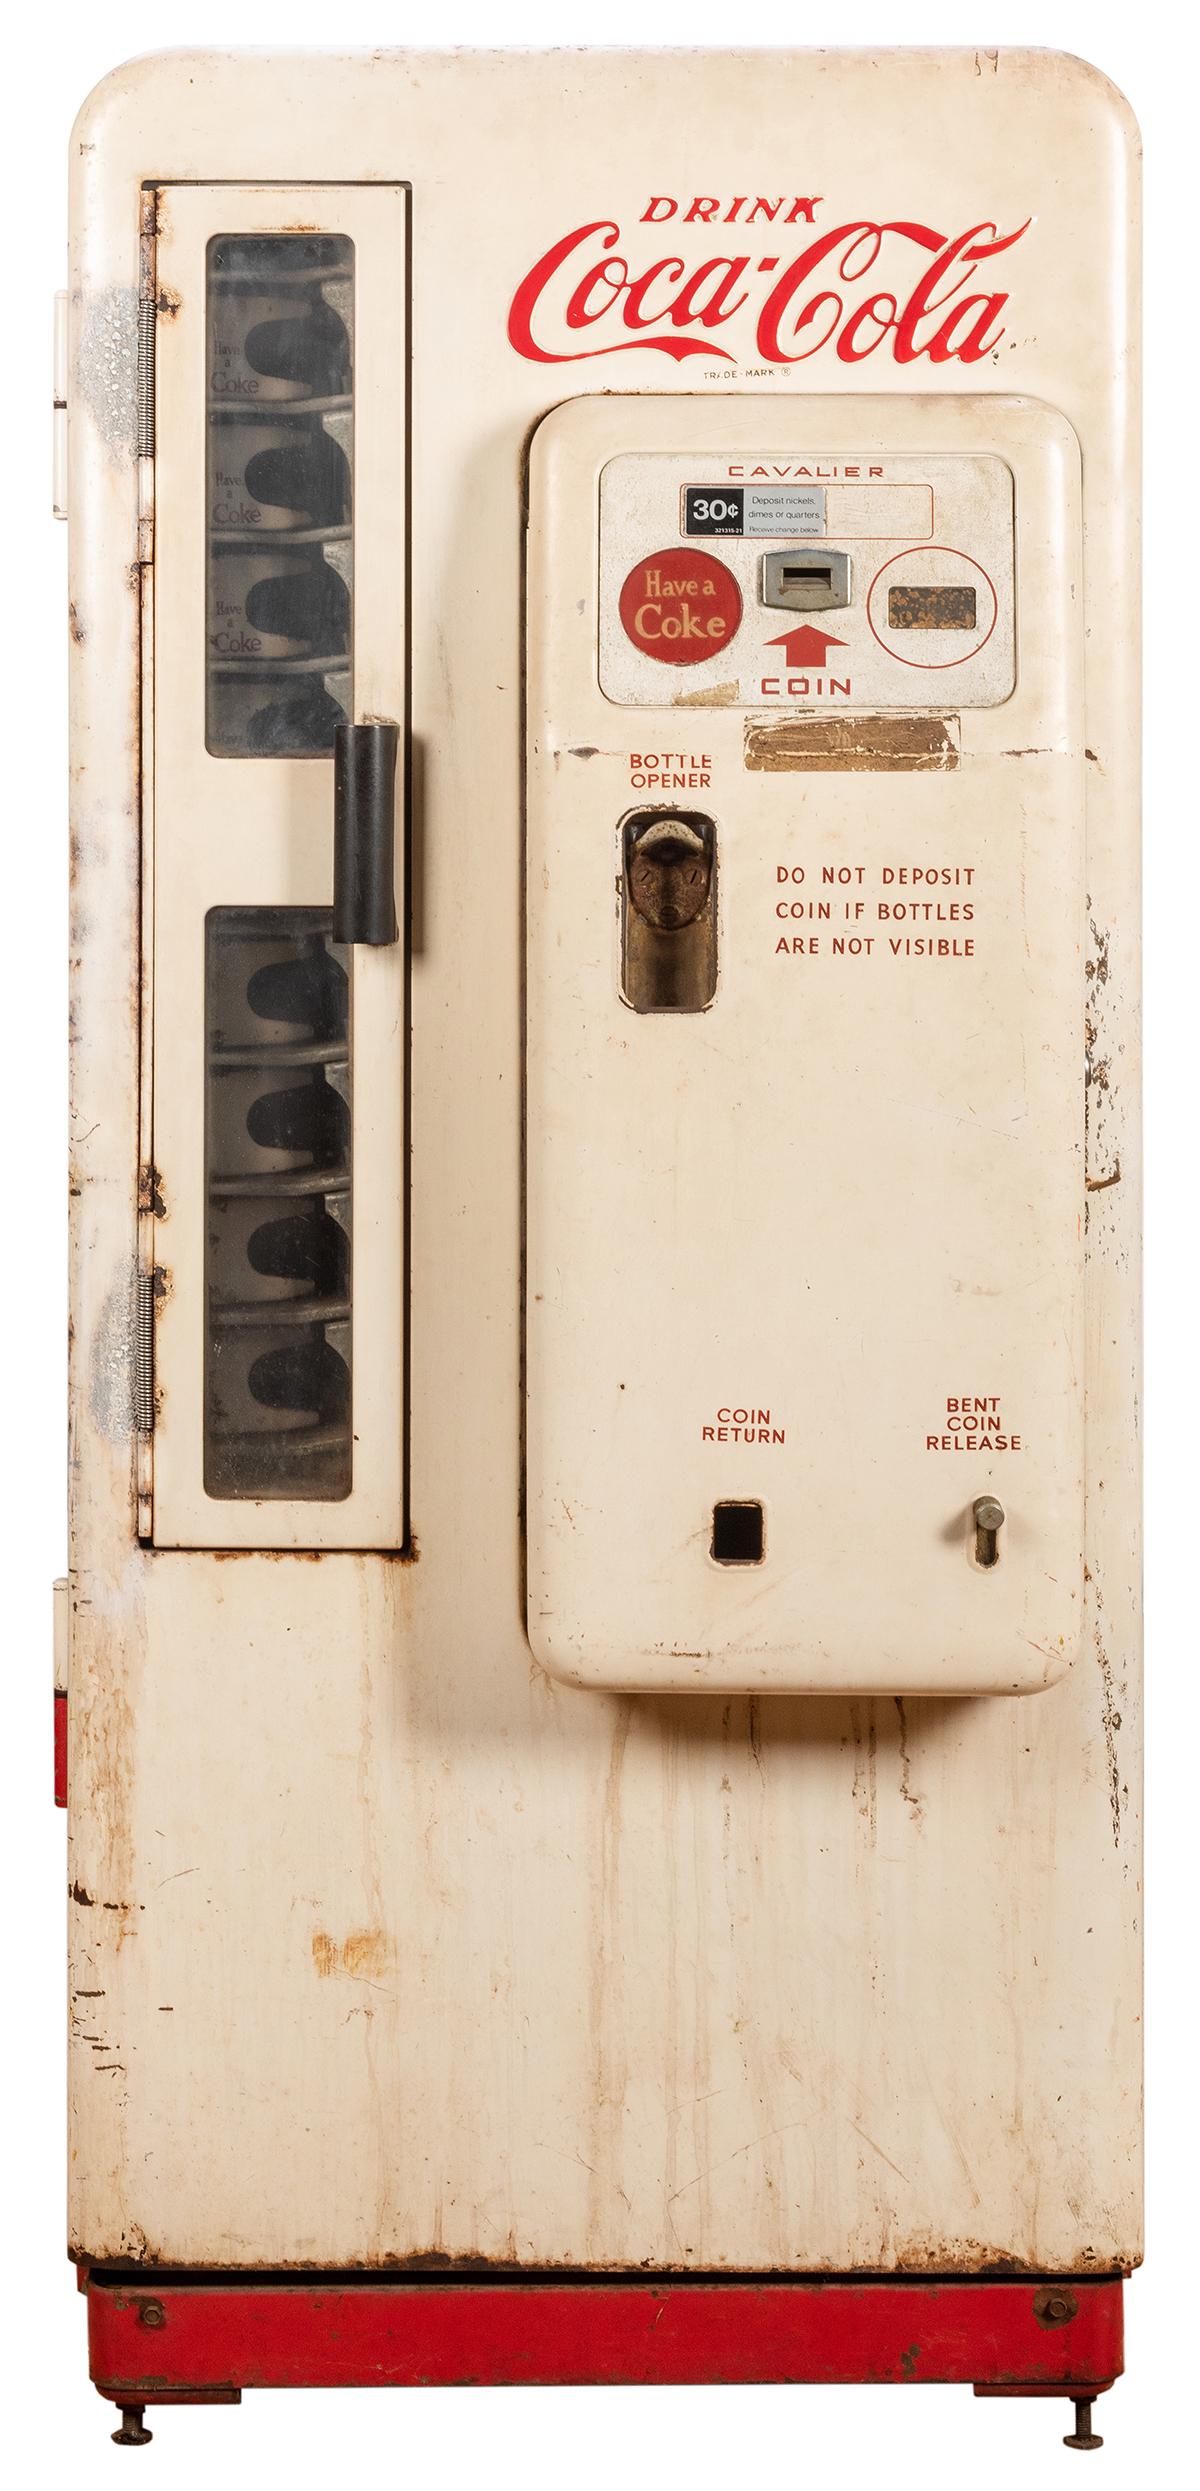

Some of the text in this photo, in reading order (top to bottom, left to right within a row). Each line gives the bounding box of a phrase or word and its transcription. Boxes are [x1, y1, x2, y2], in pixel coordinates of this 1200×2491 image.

[639, 196, 824, 223] DRINK
[506, 217, 1032, 365] Coca-Cola
[210, 371, 260, 394] Coke
[728, 465, 884, 478] CAVALIER
[692, 499, 739, 521] 30¢
[752, 496, 784, 506] Deposit
[212, 503, 262, 524] Coke
[748, 510, 821, 520] dimes or quarters
[749, 525, 774, 533] Receive
[775, 526, 799, 535] change
[644, 569, 717, 597] Have a
[634, 602, 727, 640] Coke
[213, 631, 262, 653] Coke
[761, 677, 851, 696] COIN
[629, 753, 712, 769] BOTTLE
[630, 773, 711, 788] OPENER
[776, 866, 975, 886] DO NOT DEPOSIT
[776, 902, 975, 921] COIN IF BOTTLES
[775, 938, 975, 957] ARE NOT VISIBLE
[946, 1397, 1001, 1413] BENT
[717, 1408, 771, 1425] COIN
[947, 1416, 1001, 1431] COIN
[702, 1426, 785, 1445] RETURN
[926, 1435, 1022, 1451] RELEASE
